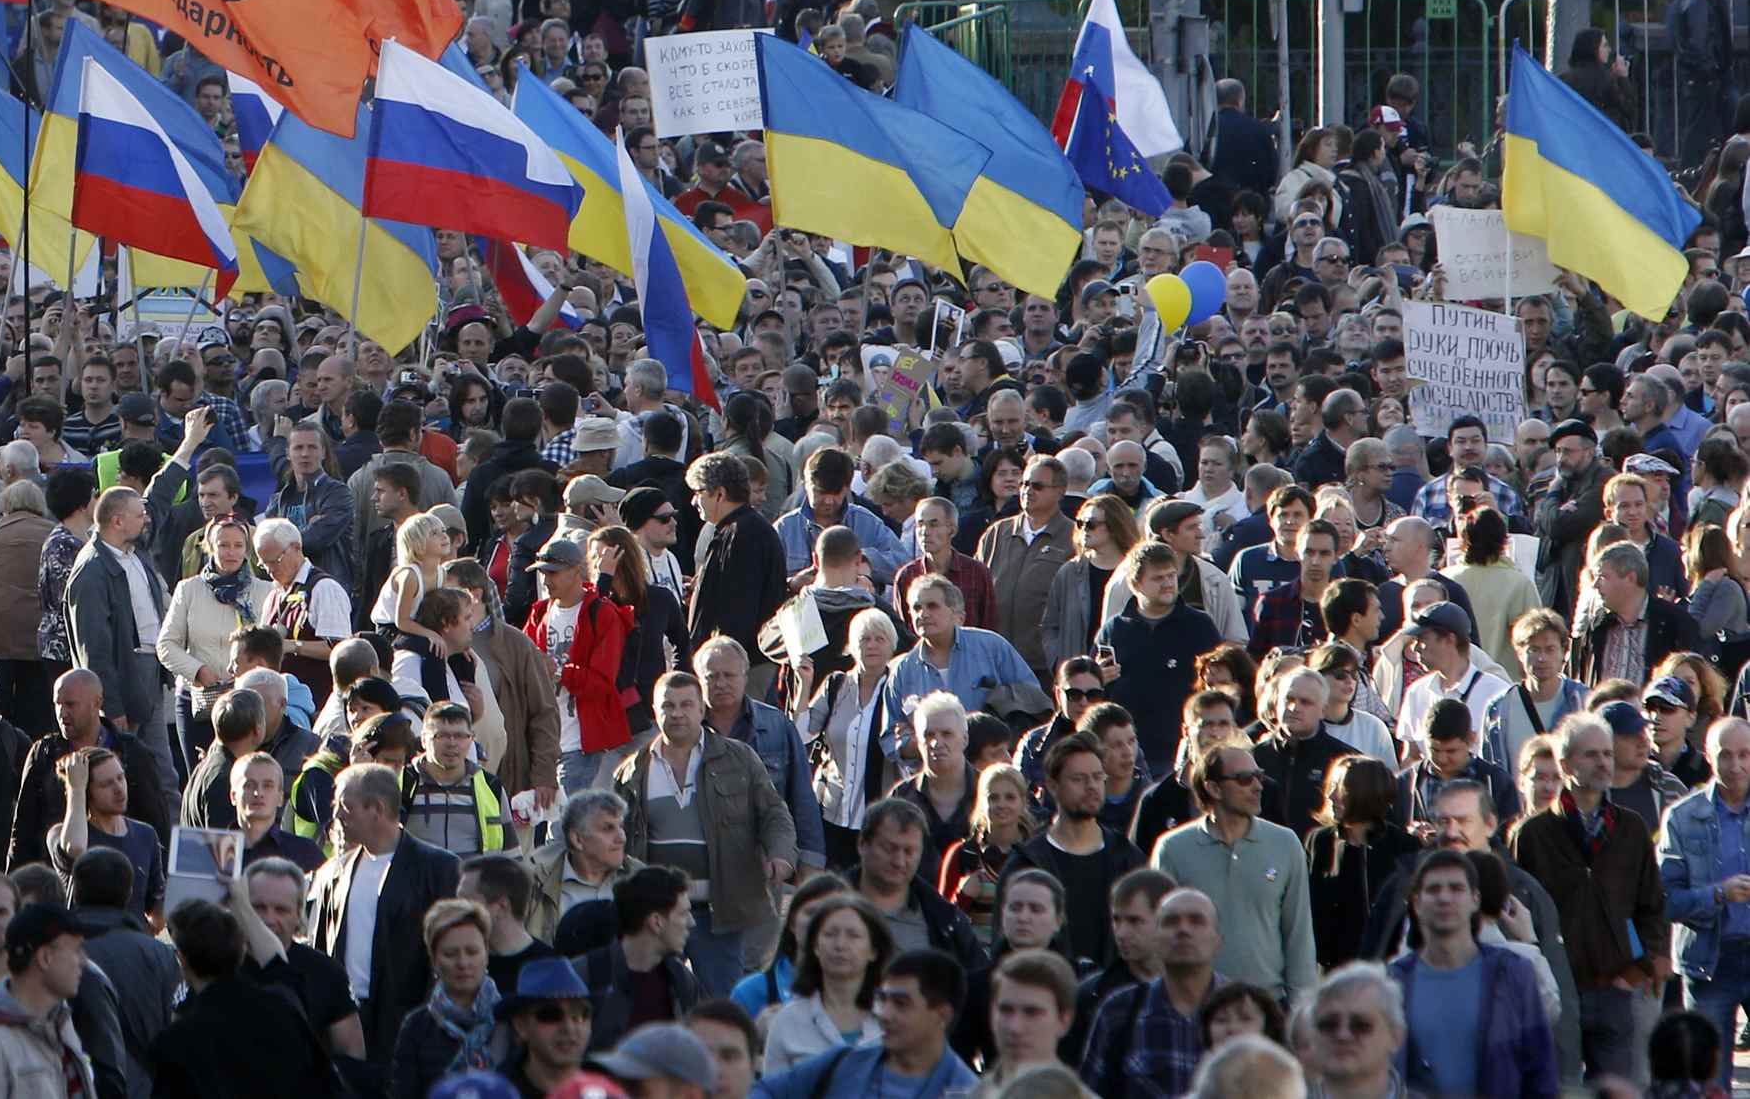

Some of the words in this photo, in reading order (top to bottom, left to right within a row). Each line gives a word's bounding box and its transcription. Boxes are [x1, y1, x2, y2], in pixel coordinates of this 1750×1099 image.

[660, 42, 712, 64] КОМУ-ТО
[670, 65, 697, 79] ЧТО
[702, 62, 711, 76] Б
[673, 106, 696, 119] КАК
[702, 103, 711, 114] В
[1409, 329, 1459, 356] РУКИ
[1468, 337, 1520, 364] ПРОЧЬ
